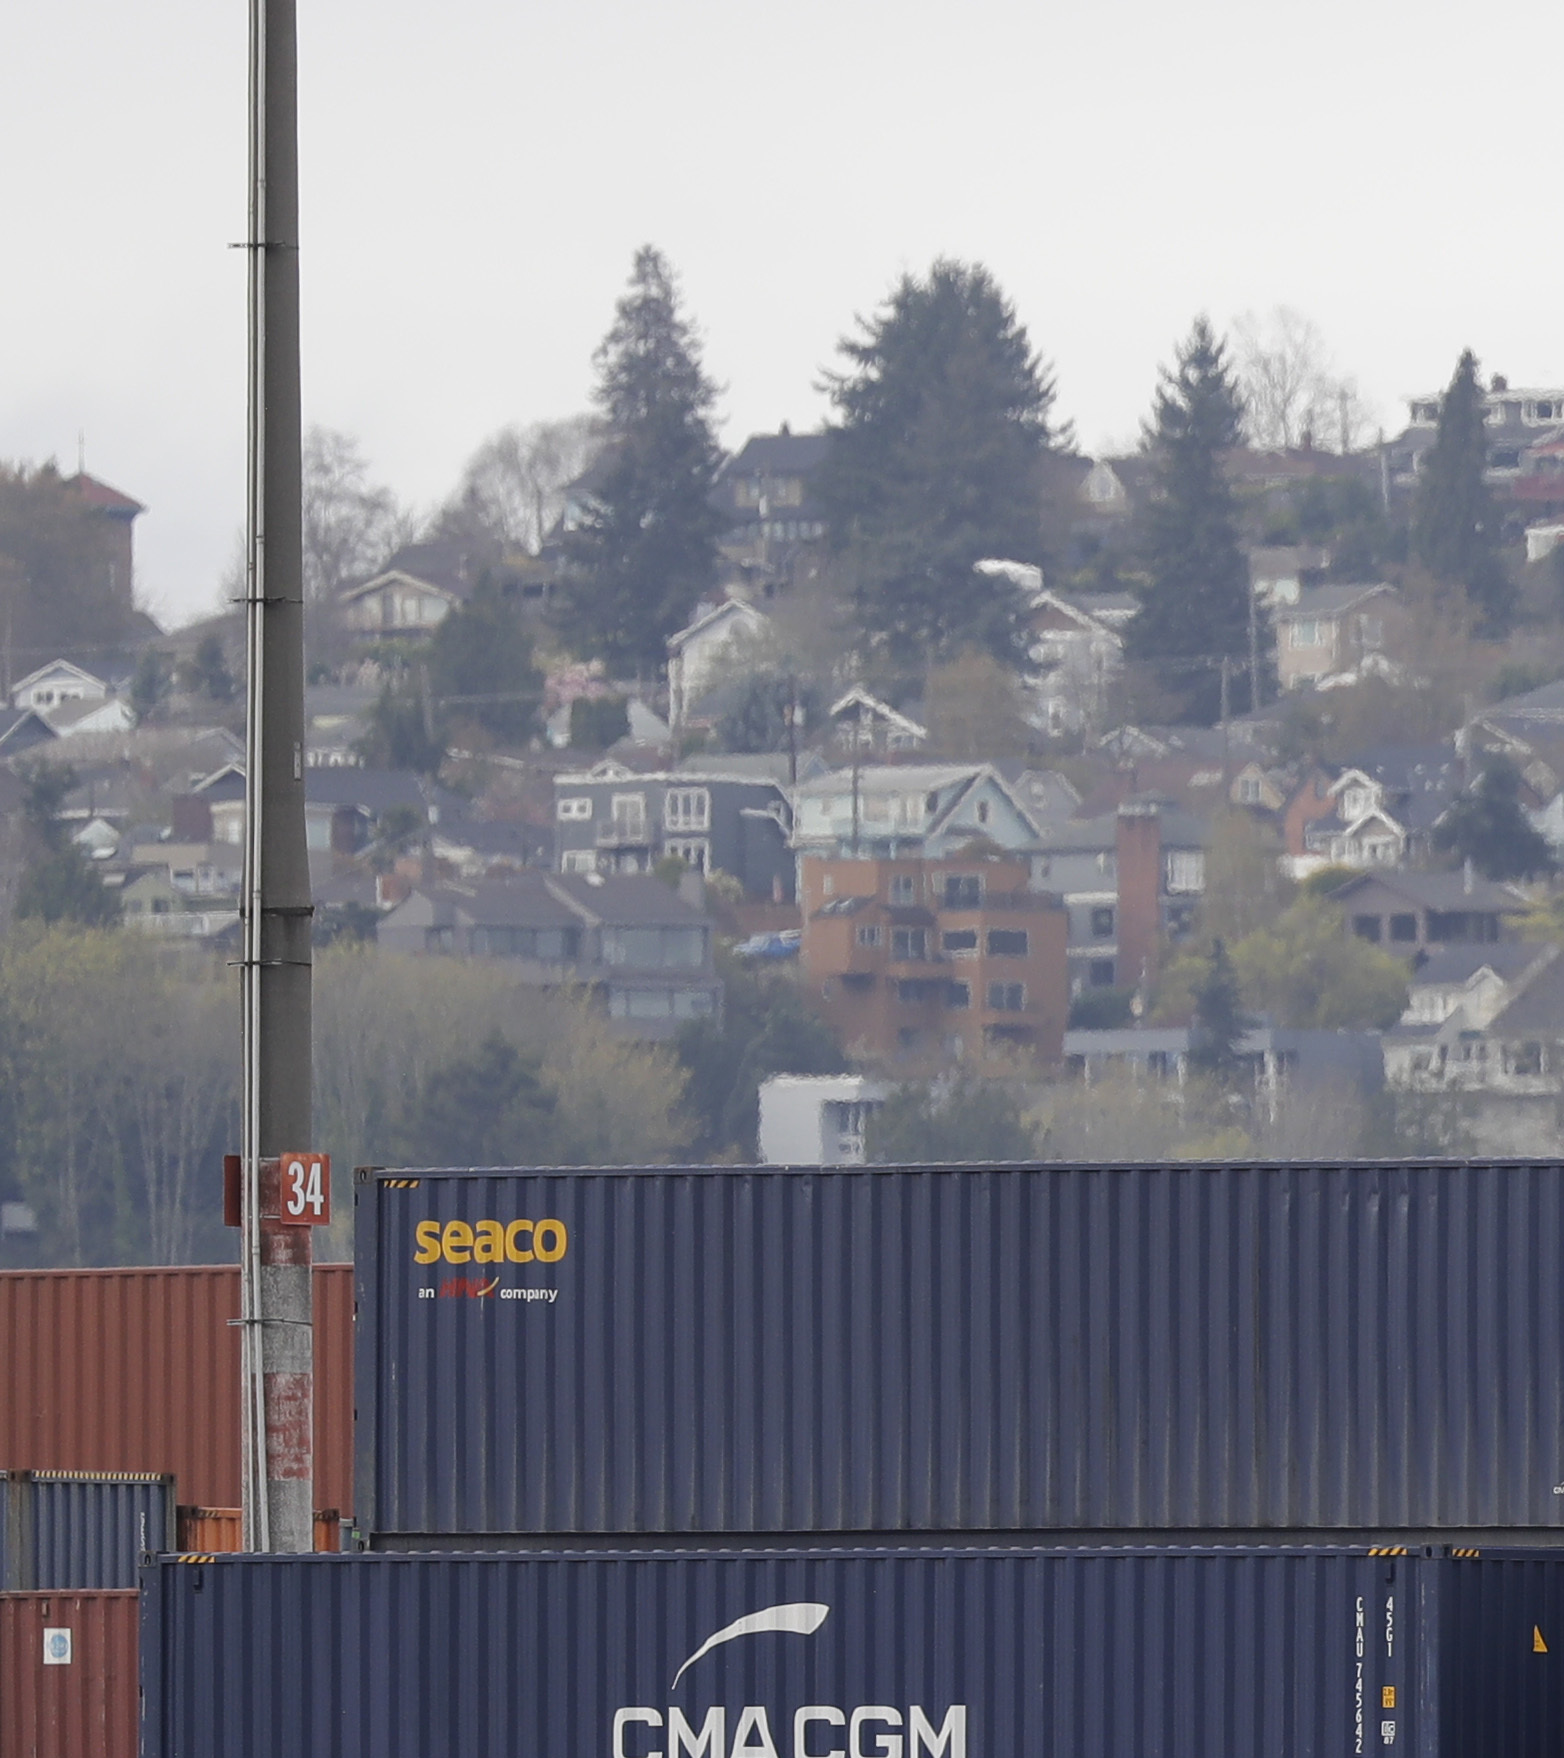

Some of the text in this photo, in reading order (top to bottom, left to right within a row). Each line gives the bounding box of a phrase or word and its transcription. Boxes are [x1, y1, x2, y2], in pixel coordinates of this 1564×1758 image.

[287, 1161, 324, 1216] 34
[414, 1219, 568, 1265] seaco
[418, 1287, 435, 1299] an
[500, 1287, 558, 1302] company
[1355, 1596, 1364, 1657] CMAU
[1385, 1596, 1394, 1657] 45G1
[1355, 1662, 1363, 1753] 745642
